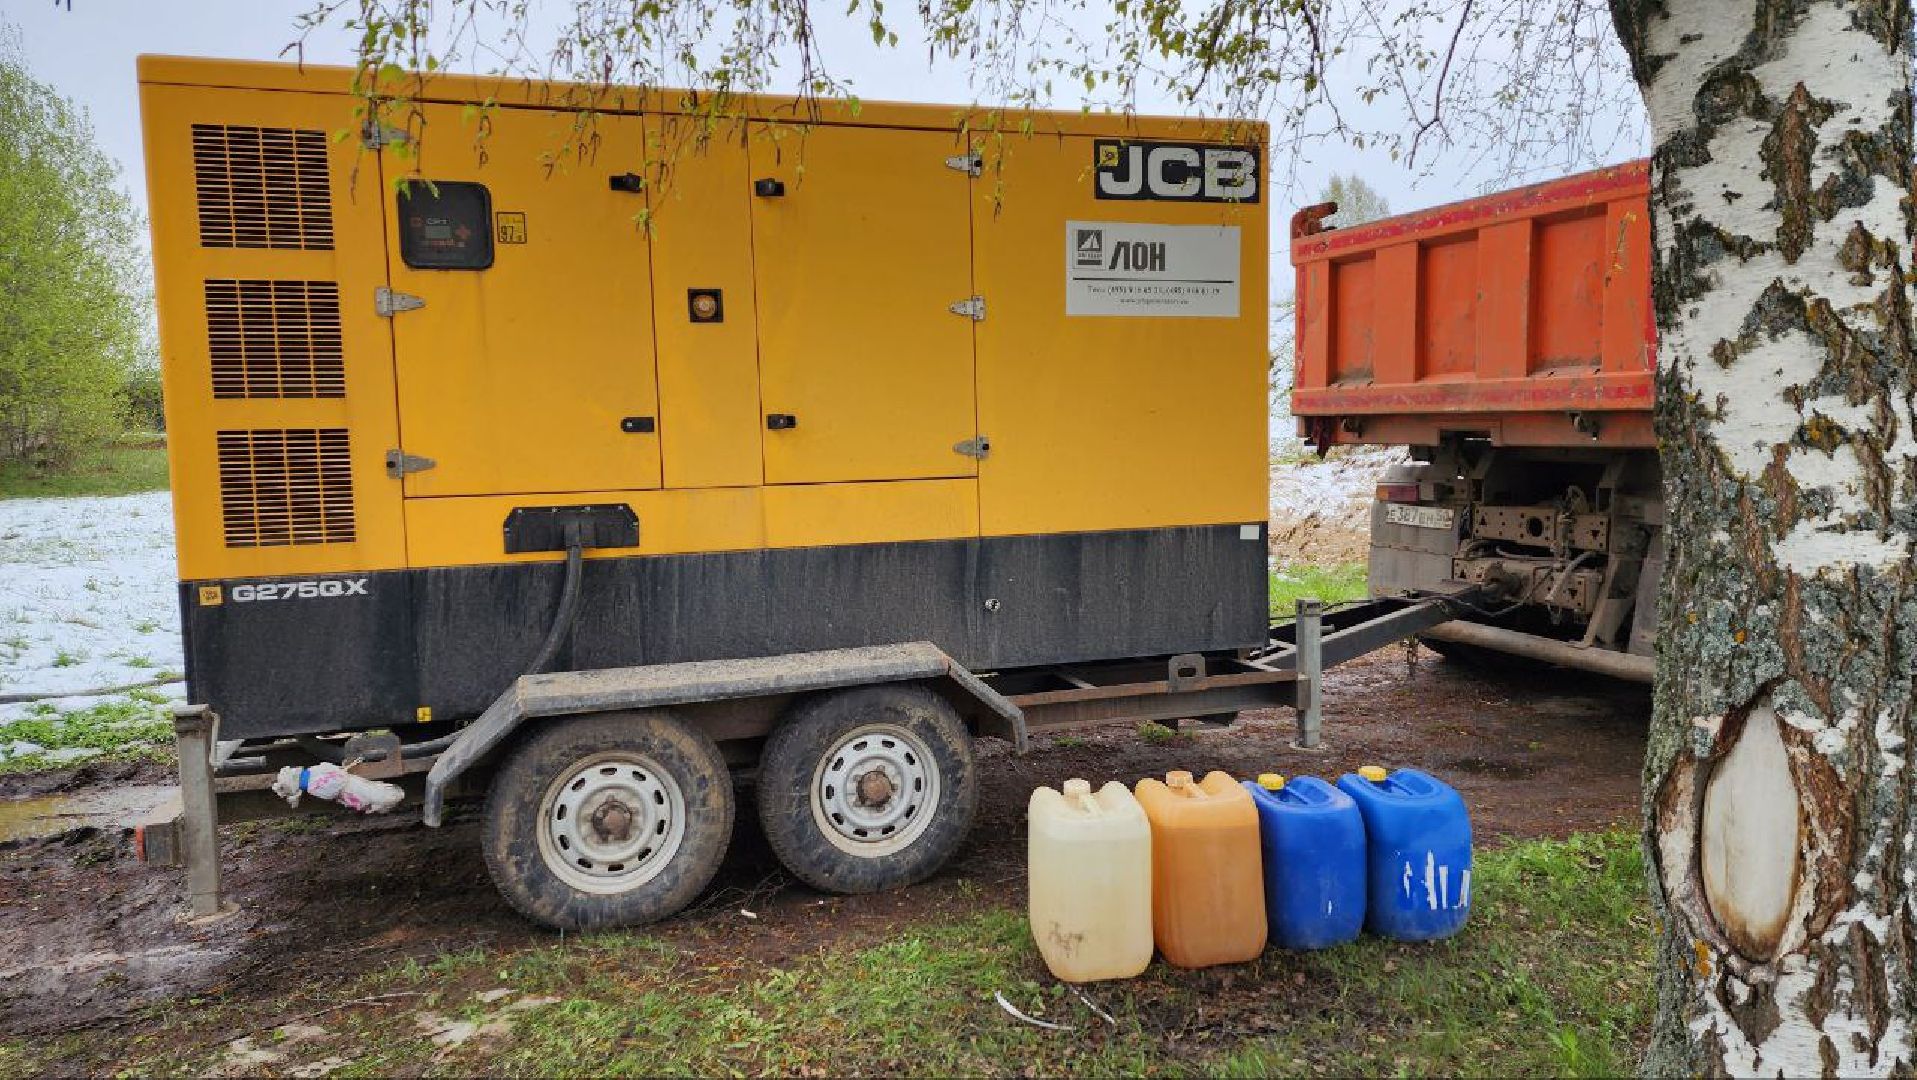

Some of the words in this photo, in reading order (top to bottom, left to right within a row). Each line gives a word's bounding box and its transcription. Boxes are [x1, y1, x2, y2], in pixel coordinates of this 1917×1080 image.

[1099, 145, 1257, 198] JCB
[1108, 240, 1166, 272] ЛОН
[232, 578, 369, 602] G275QX
